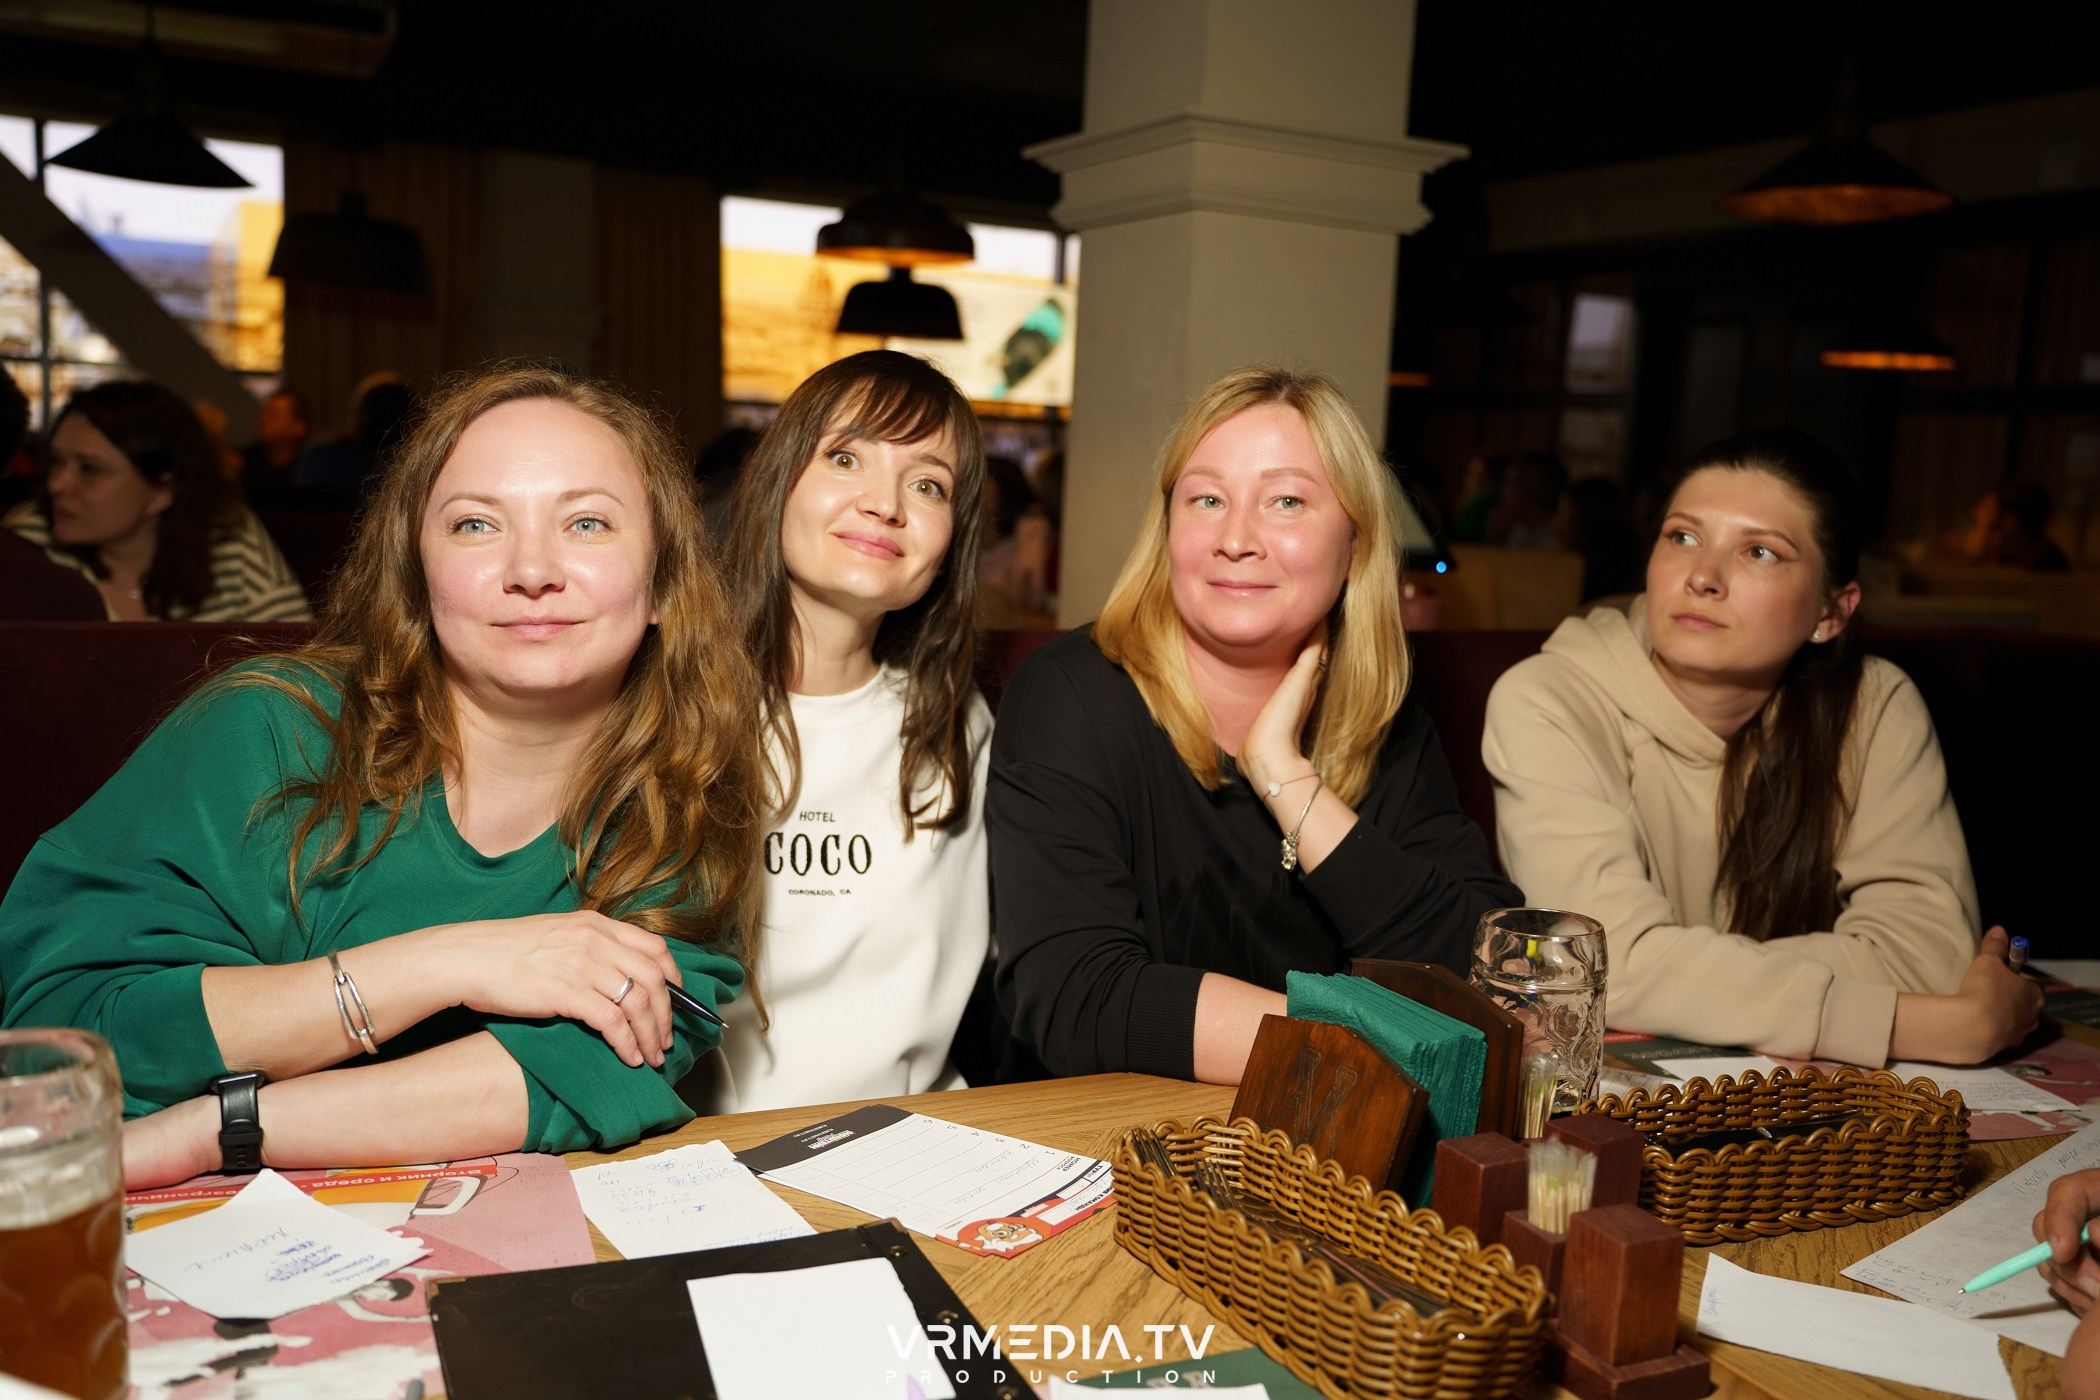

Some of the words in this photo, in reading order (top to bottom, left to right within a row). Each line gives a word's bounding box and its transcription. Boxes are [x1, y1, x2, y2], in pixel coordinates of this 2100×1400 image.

[799, 811, 836, 823] HOTEL
[764, 832, 872, 876] COCO
[396, 1168, 482, 1181] Вторник
[311, 1177, 375, 1188] среда
[124, 1189, 239, 1202] езграничн
